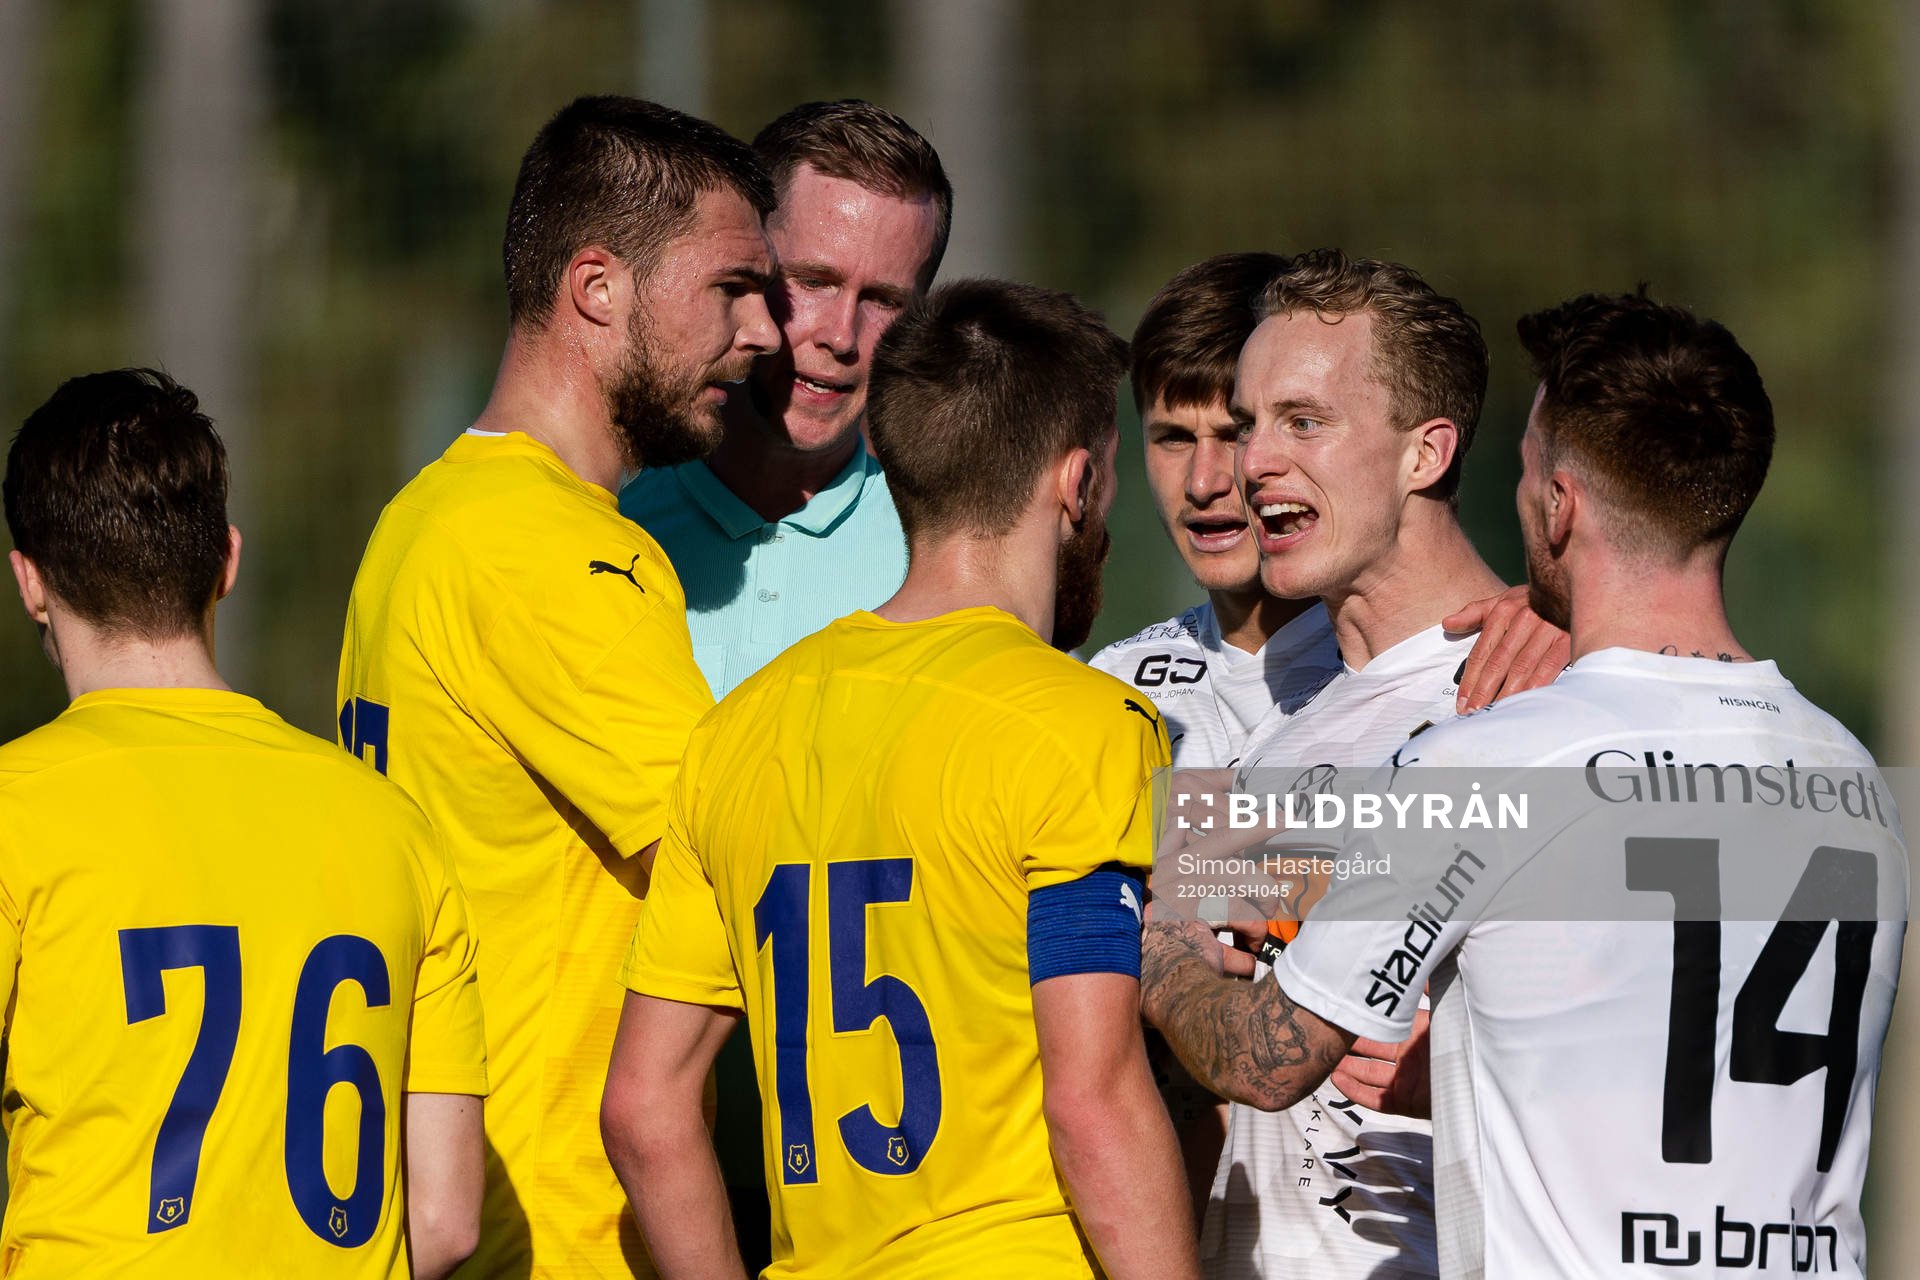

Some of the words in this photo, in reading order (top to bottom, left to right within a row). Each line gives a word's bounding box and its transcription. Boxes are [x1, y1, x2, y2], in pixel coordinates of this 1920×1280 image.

[1164, 687, 1195, 699] JOHAN
[1718, 695, 1781, 715] HISINGEN
[1585, 749, 1888, 828] Glimstedt
[1364, 846, 1487, 1017] stadium
[1624, 836, 1878, 1174] 14
[117, 924, 391, 1249] 76
[752, 857, 943, 1186] 15
